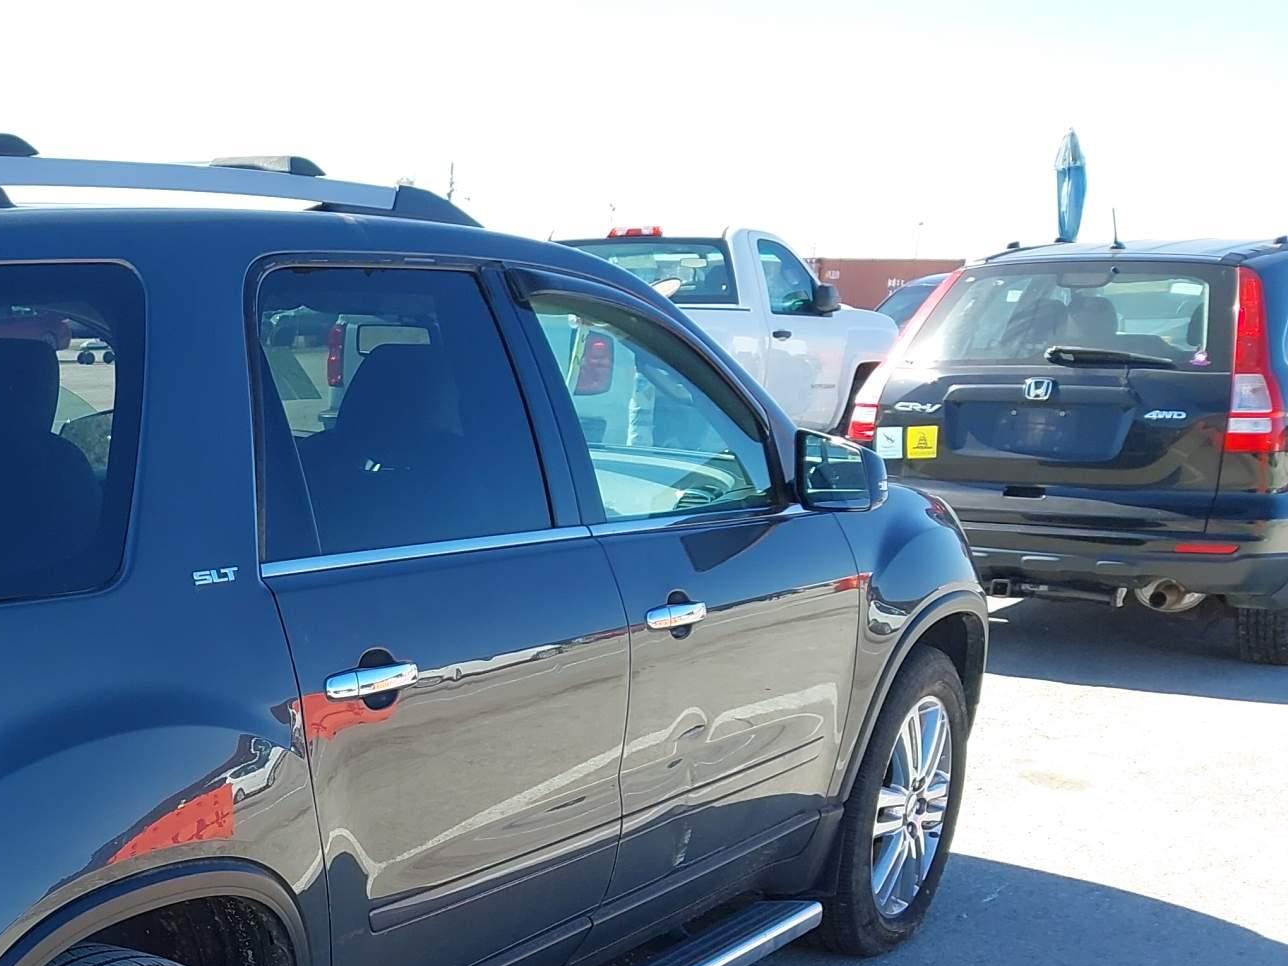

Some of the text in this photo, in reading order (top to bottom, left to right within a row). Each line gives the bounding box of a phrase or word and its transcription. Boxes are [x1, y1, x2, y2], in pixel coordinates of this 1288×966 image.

[894, 401, 943, 413] CR-V
[1143, 409, 1187, 420] 4WD
[192, 566, 239, 586] SLT
